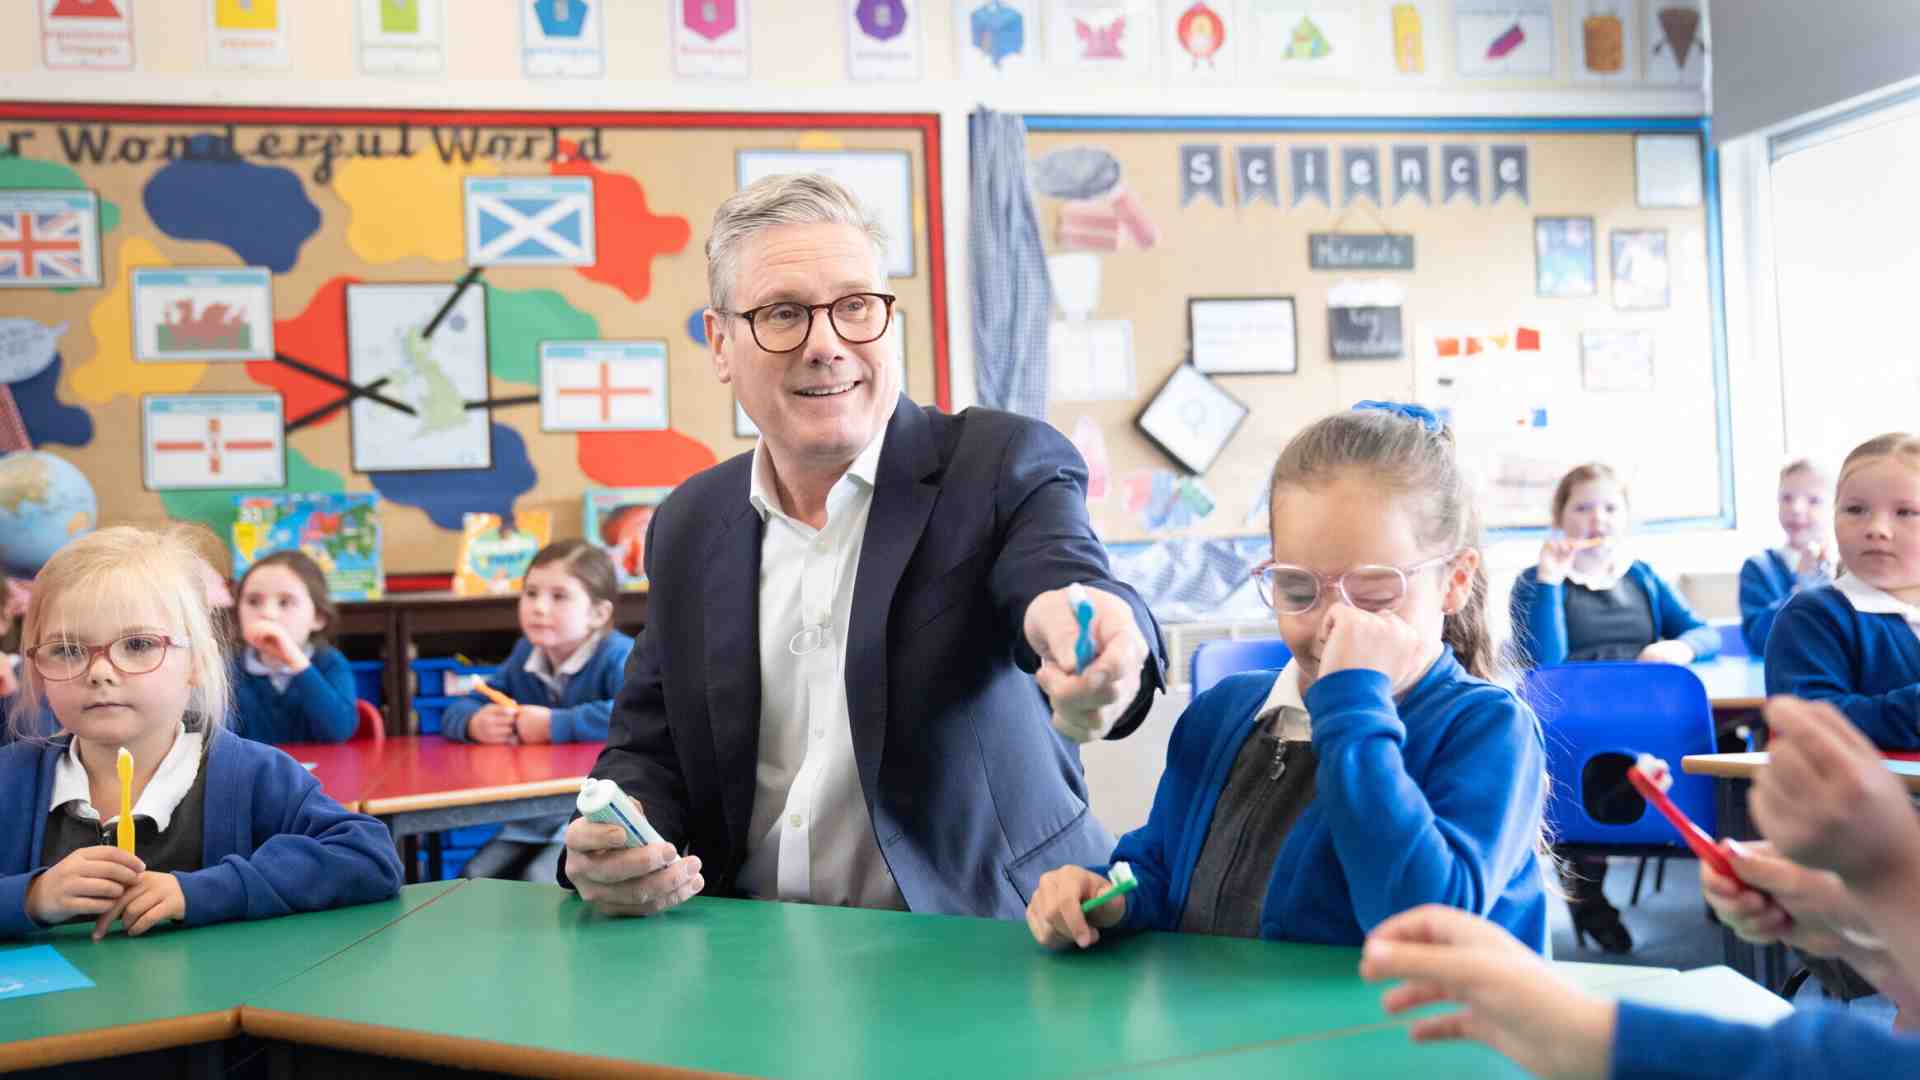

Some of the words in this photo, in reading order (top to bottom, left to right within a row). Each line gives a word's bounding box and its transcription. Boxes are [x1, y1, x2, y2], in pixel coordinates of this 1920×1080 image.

[56, 122, 413, 186] Wonderful
[430, 124, 611, 164] World
[1189, 152, 1521, 185] Science
